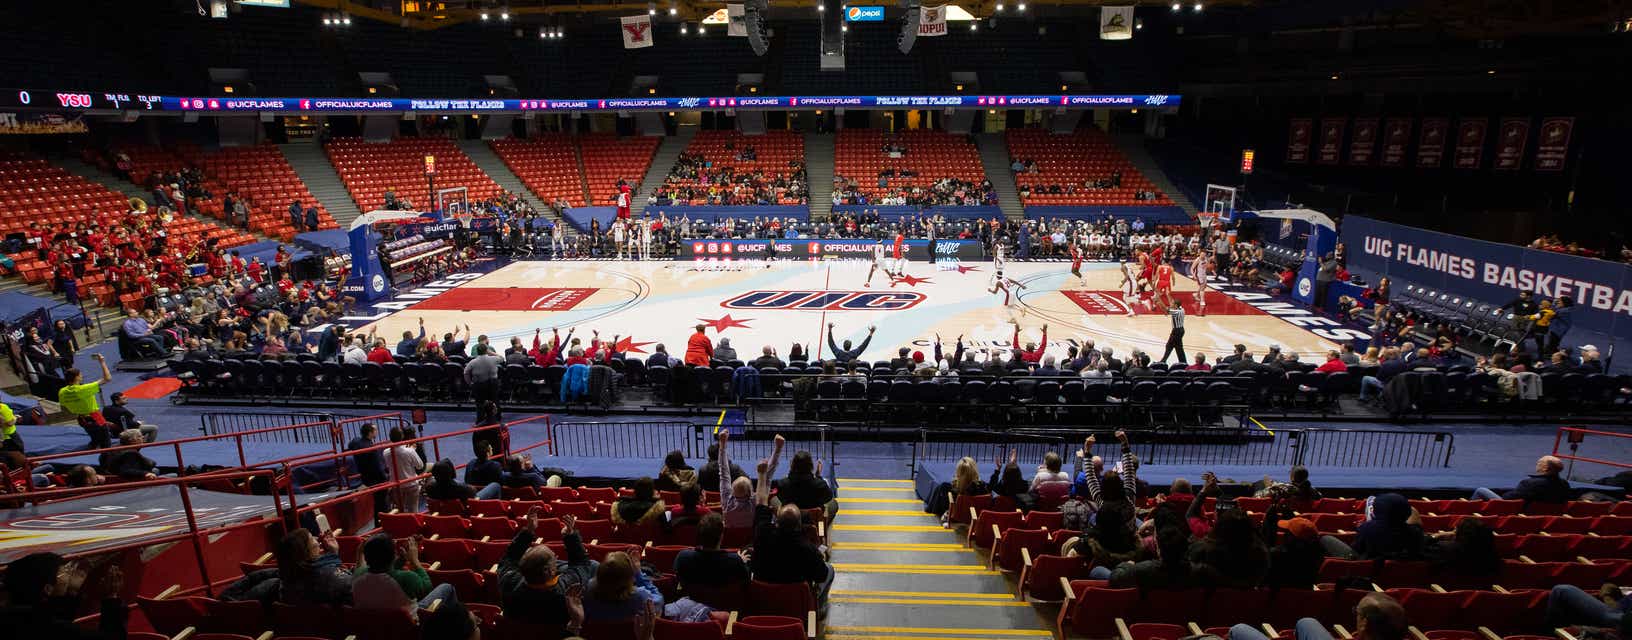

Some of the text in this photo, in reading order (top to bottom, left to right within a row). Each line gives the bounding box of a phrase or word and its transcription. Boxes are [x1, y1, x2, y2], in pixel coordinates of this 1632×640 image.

[861, 10, 881, 18] pepsi
[18, 90, 31, 104] 0
[56, 93, 93, 107] YSU
[800, 97, 861, 105] OFFICIALUICFLAMES
[876, 96, 962, 105] FOLLOW THE FLAMES
[1009, 96, 1050, 105] @UICFLAMES
[1072, 96, 1133, 105] OFFICIALUICFLAMES
[226, 100, 284, 109] @UICFLAMES
[315, 100, 393, 109] OFFICIALUICFLAMES
[411, 99, 505, 109] FOLLOW THE FLAMES
[551, 101, 588, 109] @UICFLAMES
[609, 99, 667, 108] OFFICIALUICFLAMES
[740, 98, 779, 106] @UICFLAMES
[1364, 235, 1632, 317] UIC FLAMES BASKETBA
[724, 290, 922, 310] UIC
